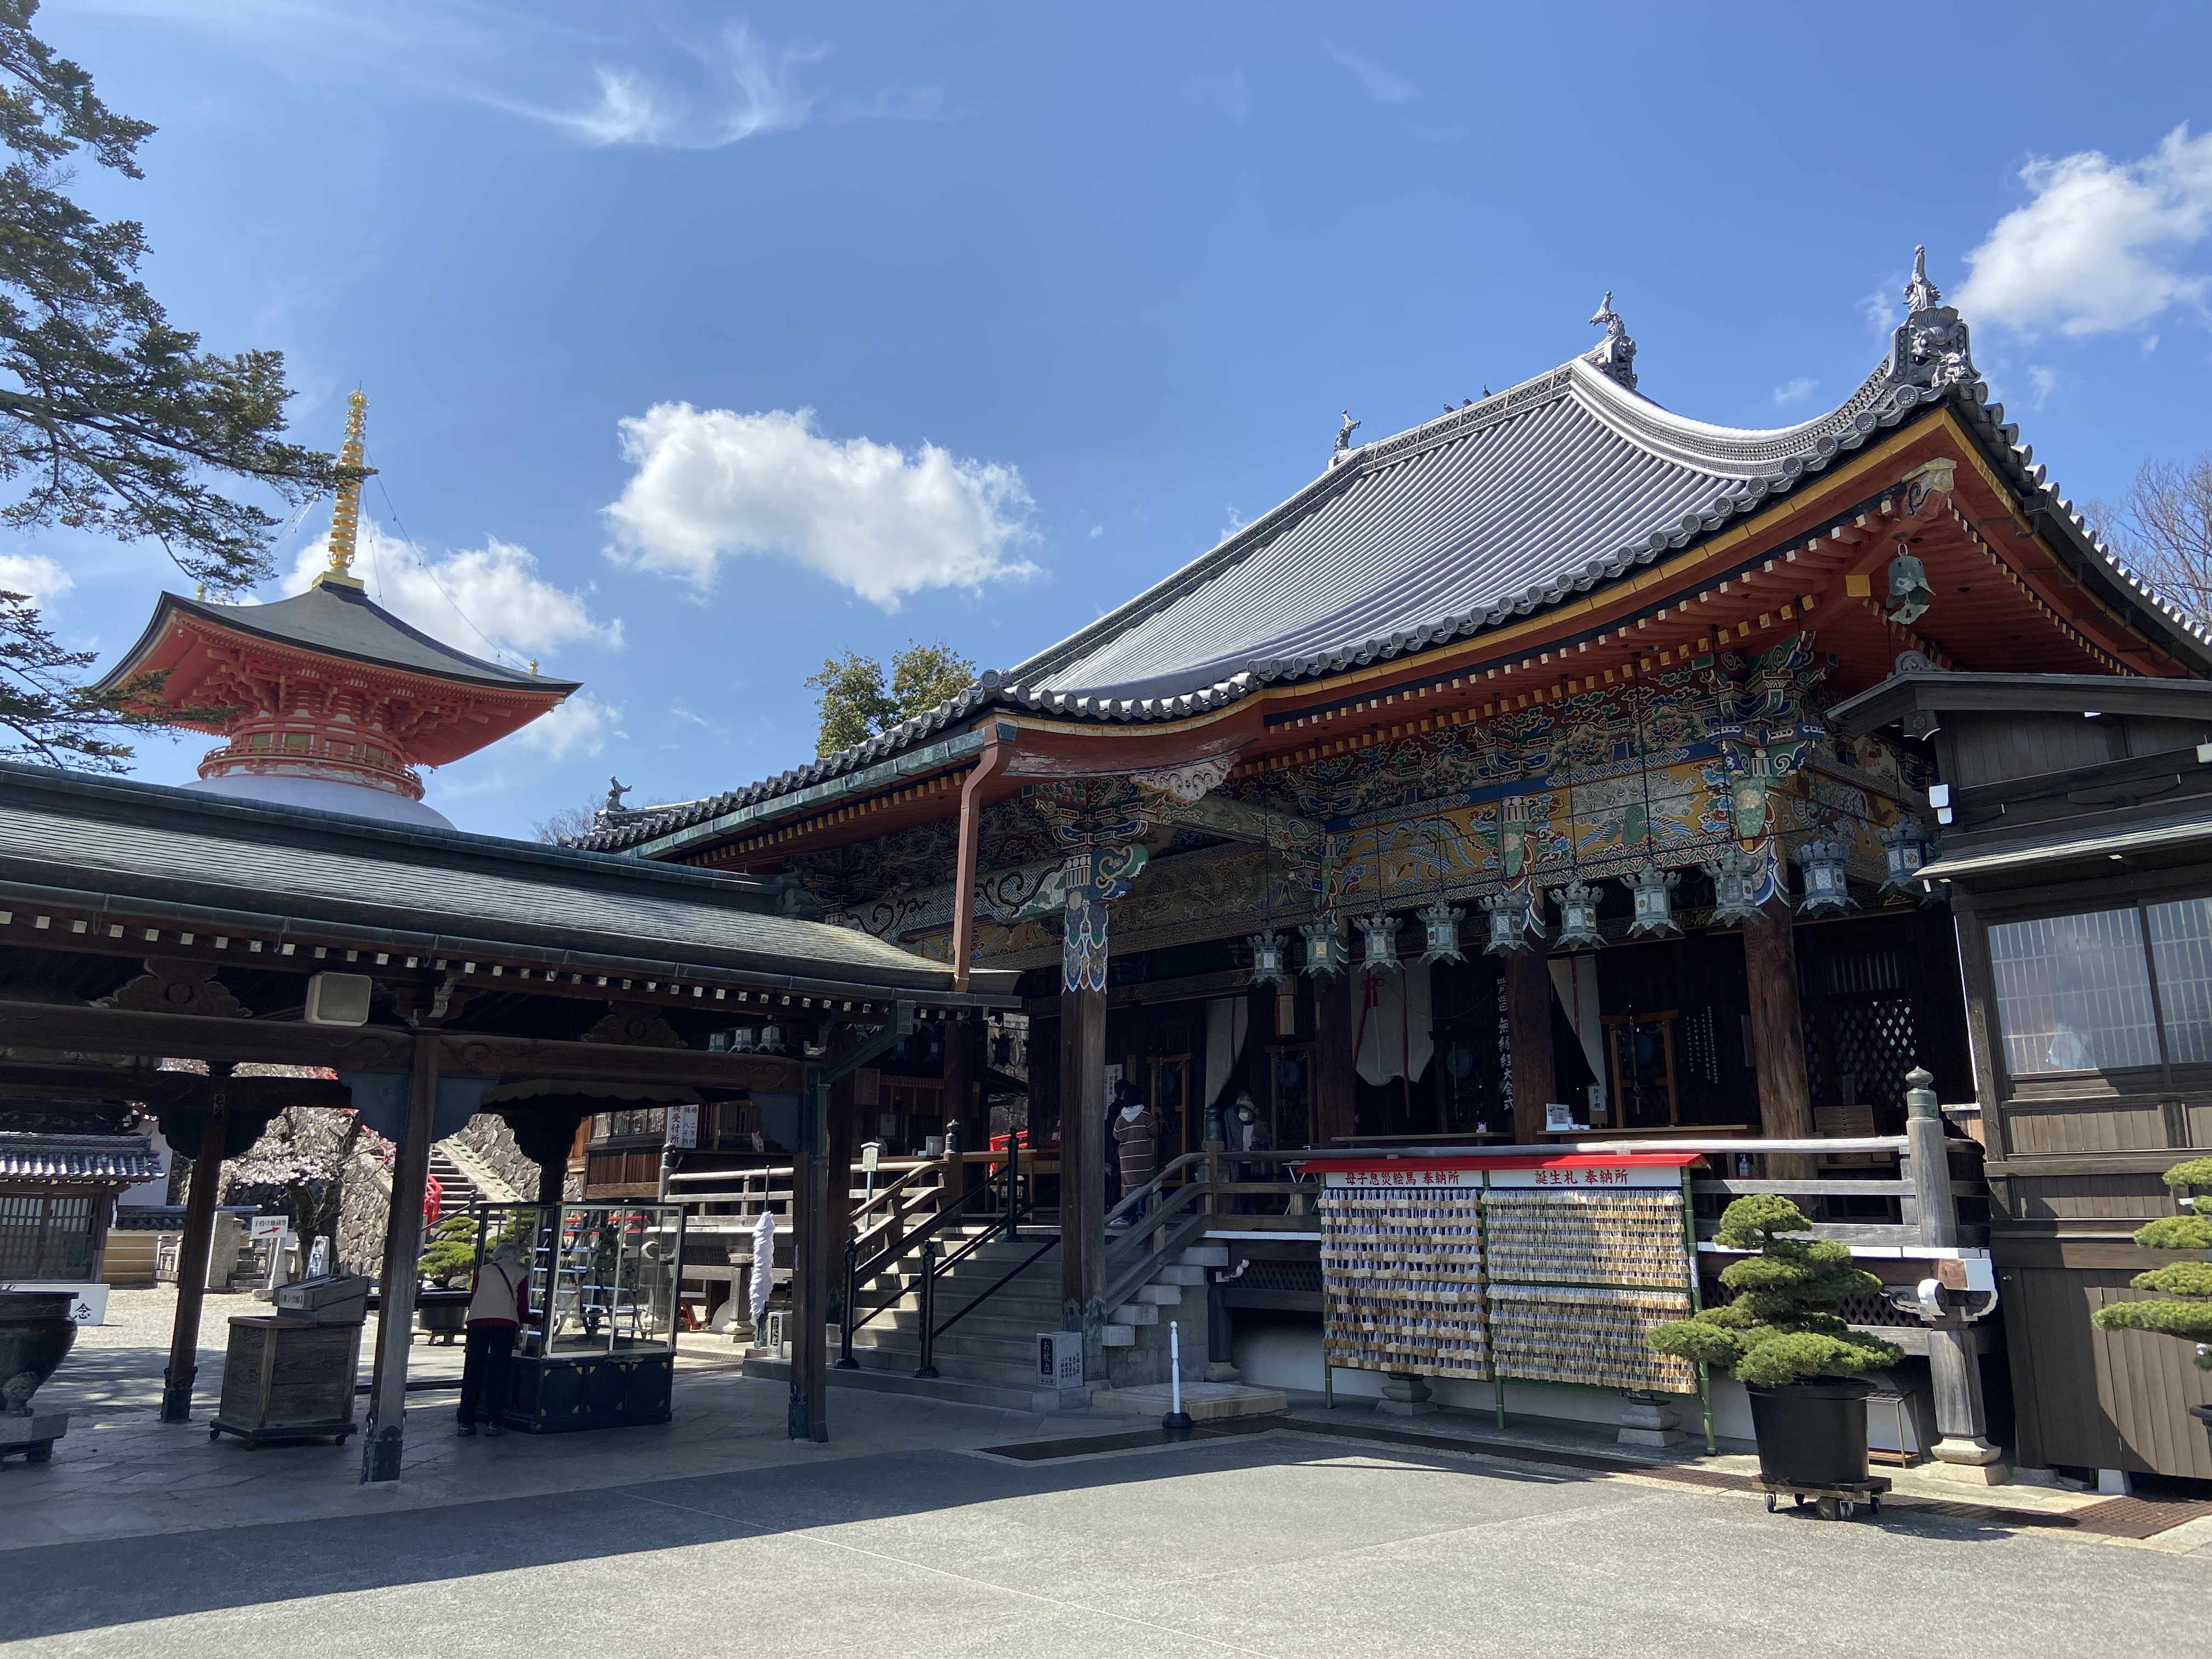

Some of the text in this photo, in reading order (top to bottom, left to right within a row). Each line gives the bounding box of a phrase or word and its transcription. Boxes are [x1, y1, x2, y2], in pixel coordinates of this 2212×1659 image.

[1345, 1171, 1459, 1186] 母子息災絵馬 奉納所
[1534, 1169, 1629, 1185] 誕生札 奉納所
[1043, 1340, 1052, 1373] お杖立
